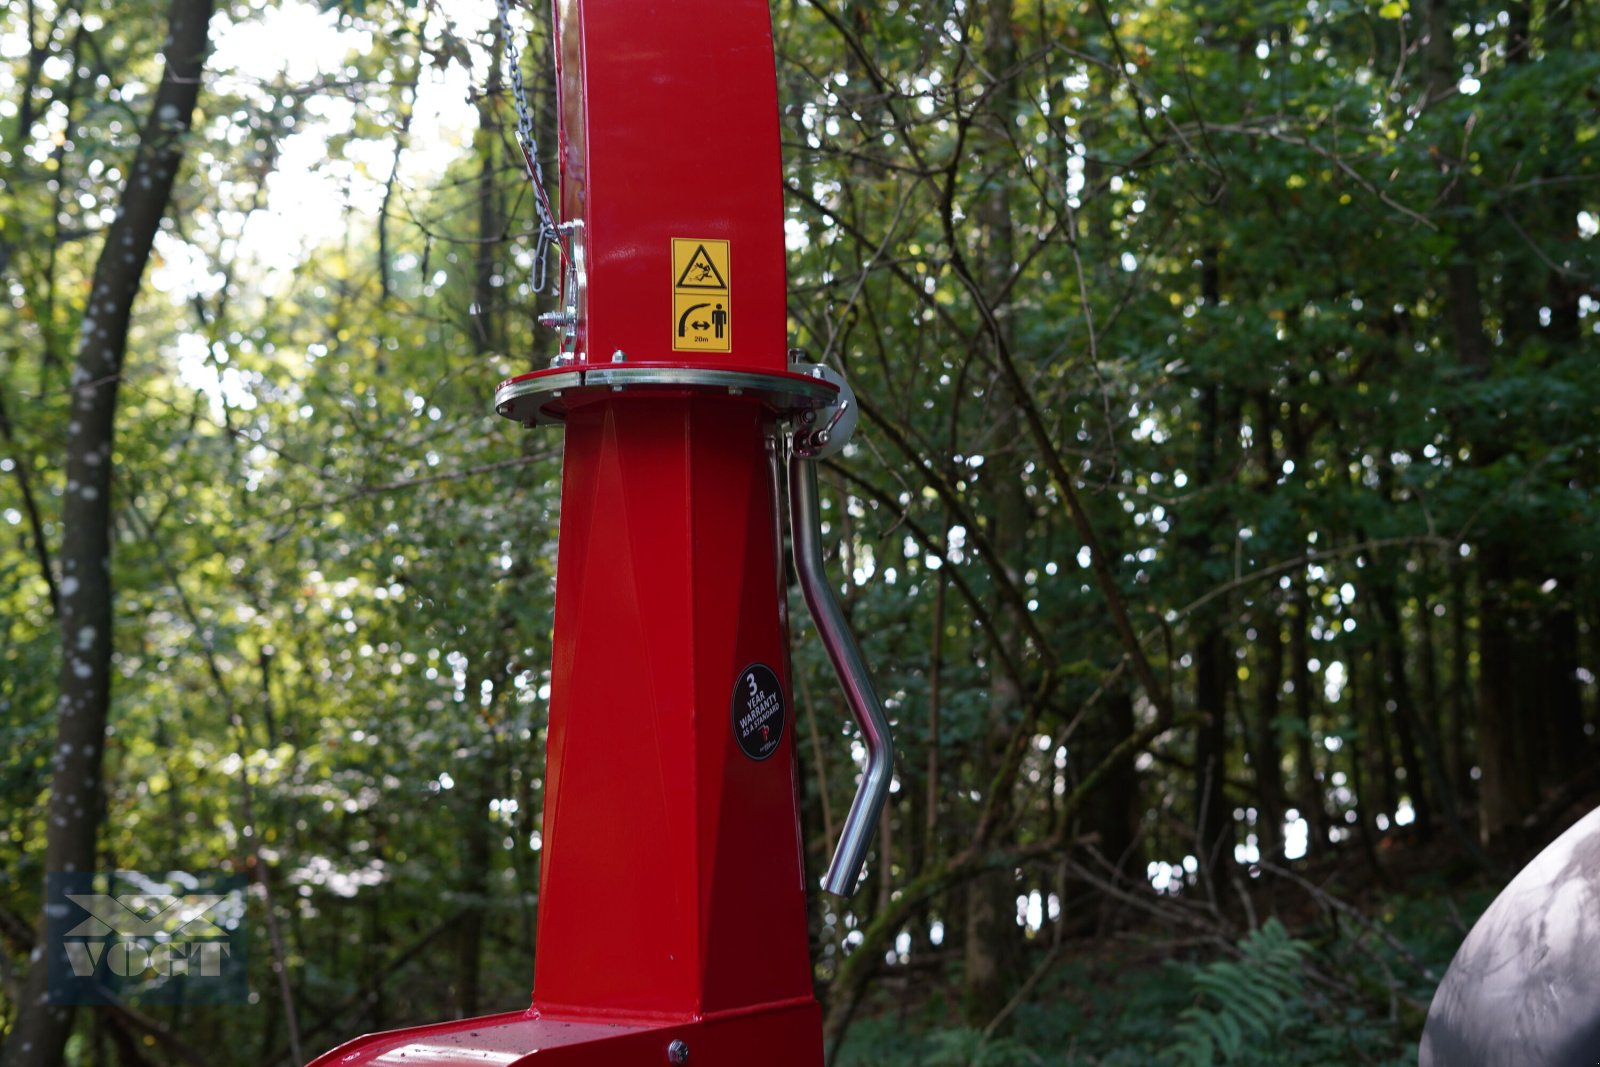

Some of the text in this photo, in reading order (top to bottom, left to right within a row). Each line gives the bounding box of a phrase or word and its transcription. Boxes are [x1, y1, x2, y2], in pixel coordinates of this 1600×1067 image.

[746, 672, 758, 696] 3
[739, 692, 777, 729] WARRANTY
[747, 690, 766, 710] YEAR
[742, 729, 750, 738] AS
[754, 702, 780, 729] STANDARD
